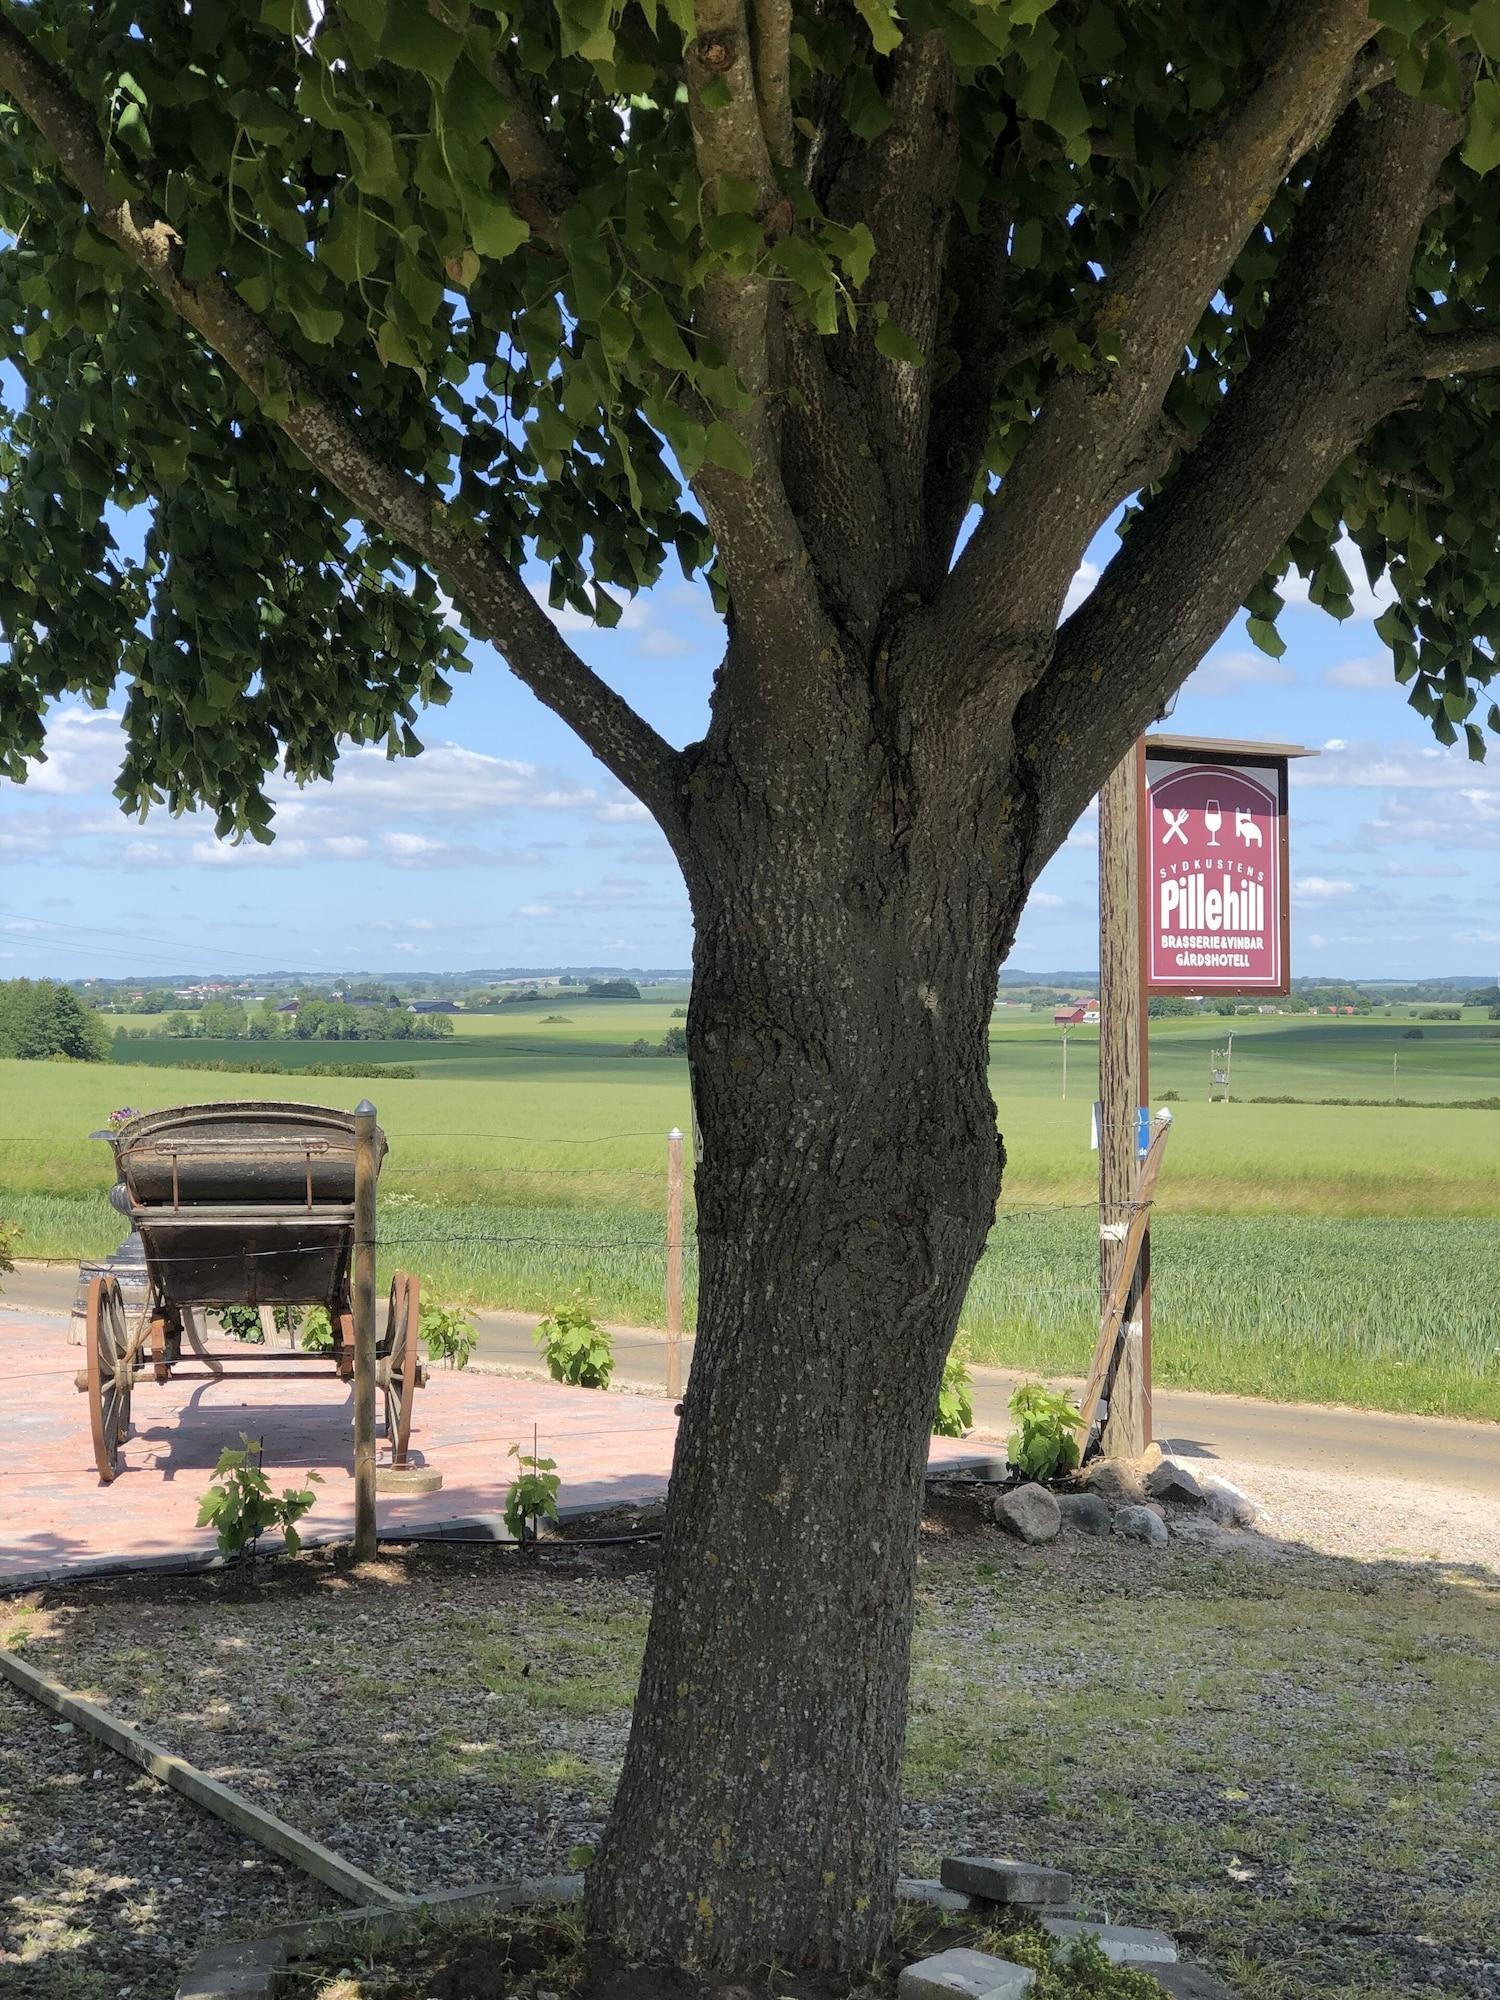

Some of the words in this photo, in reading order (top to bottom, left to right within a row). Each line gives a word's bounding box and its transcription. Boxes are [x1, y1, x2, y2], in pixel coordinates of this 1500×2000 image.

[1160, 859, 1264, 881] SYDKUSTENS
[1161, 873, 1264, 931] Pillehill
[1176, 951, 1250, 967] GÅRDSHOTELL
